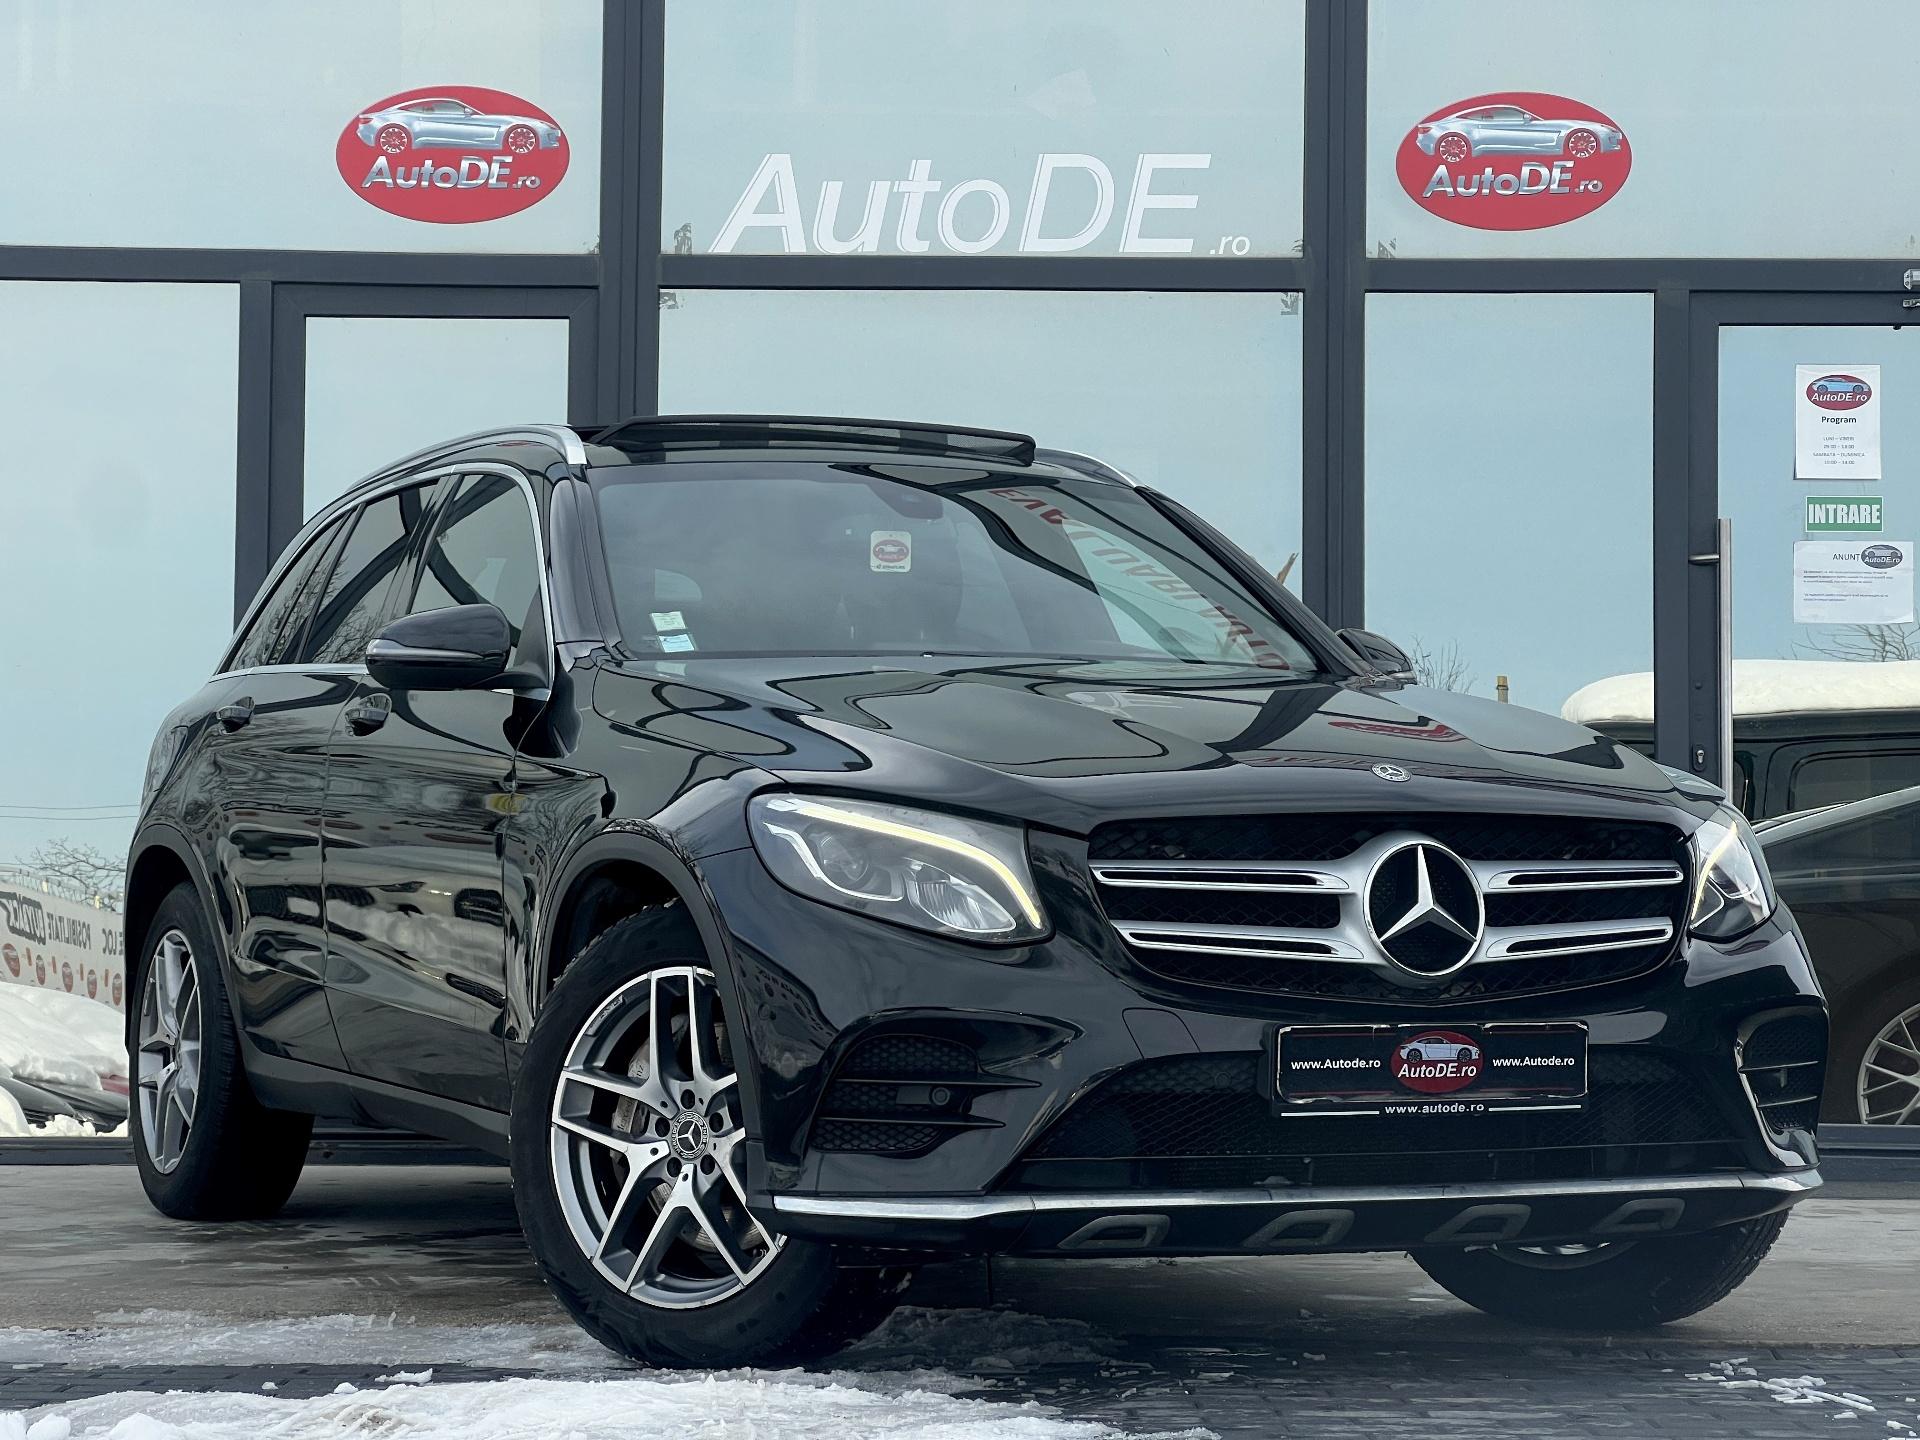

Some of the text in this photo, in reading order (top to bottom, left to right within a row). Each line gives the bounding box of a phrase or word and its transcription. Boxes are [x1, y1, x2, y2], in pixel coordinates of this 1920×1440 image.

[1811, 392, 1868, 402] AutoDE.ro
[1821, 416, 1857, 425] Program
[1808, 503, 1881, 524] INTRARE
[1291, 1055, 1575, 1079] www.Autode.ro AutoDE.ro www.Autode.ro
[1384, 1101, 1485, 1114] www.autode.ro
